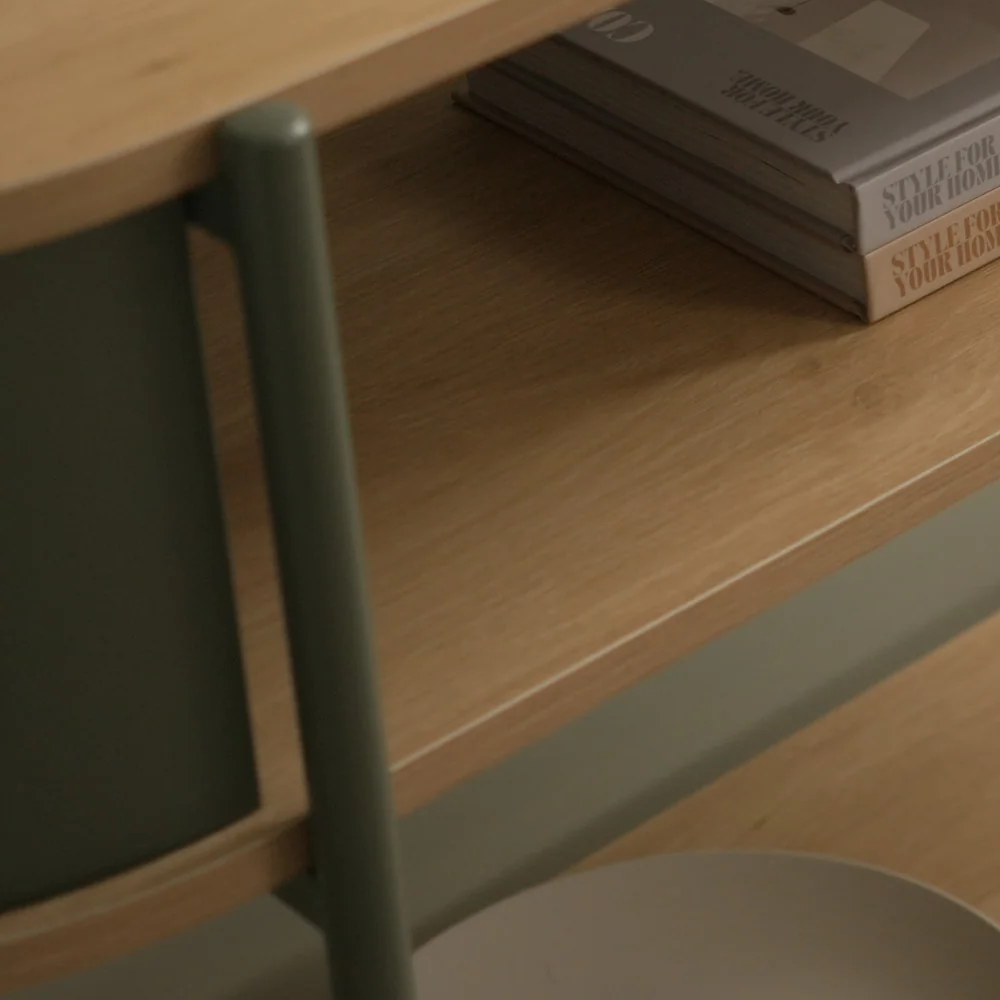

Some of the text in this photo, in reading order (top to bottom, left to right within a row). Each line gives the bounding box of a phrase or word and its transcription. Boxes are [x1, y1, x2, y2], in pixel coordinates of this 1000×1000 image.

[720, 87, 828, 143] STYLE FOR
[788, 100, 849, 137] YOUR
[882, 134, 996, 207] STYLE FOR
[883, 183, 943, 230] YOUR
[891, 222, 960, 273] STYLE
[892, 250, 953, 298] YOUR
